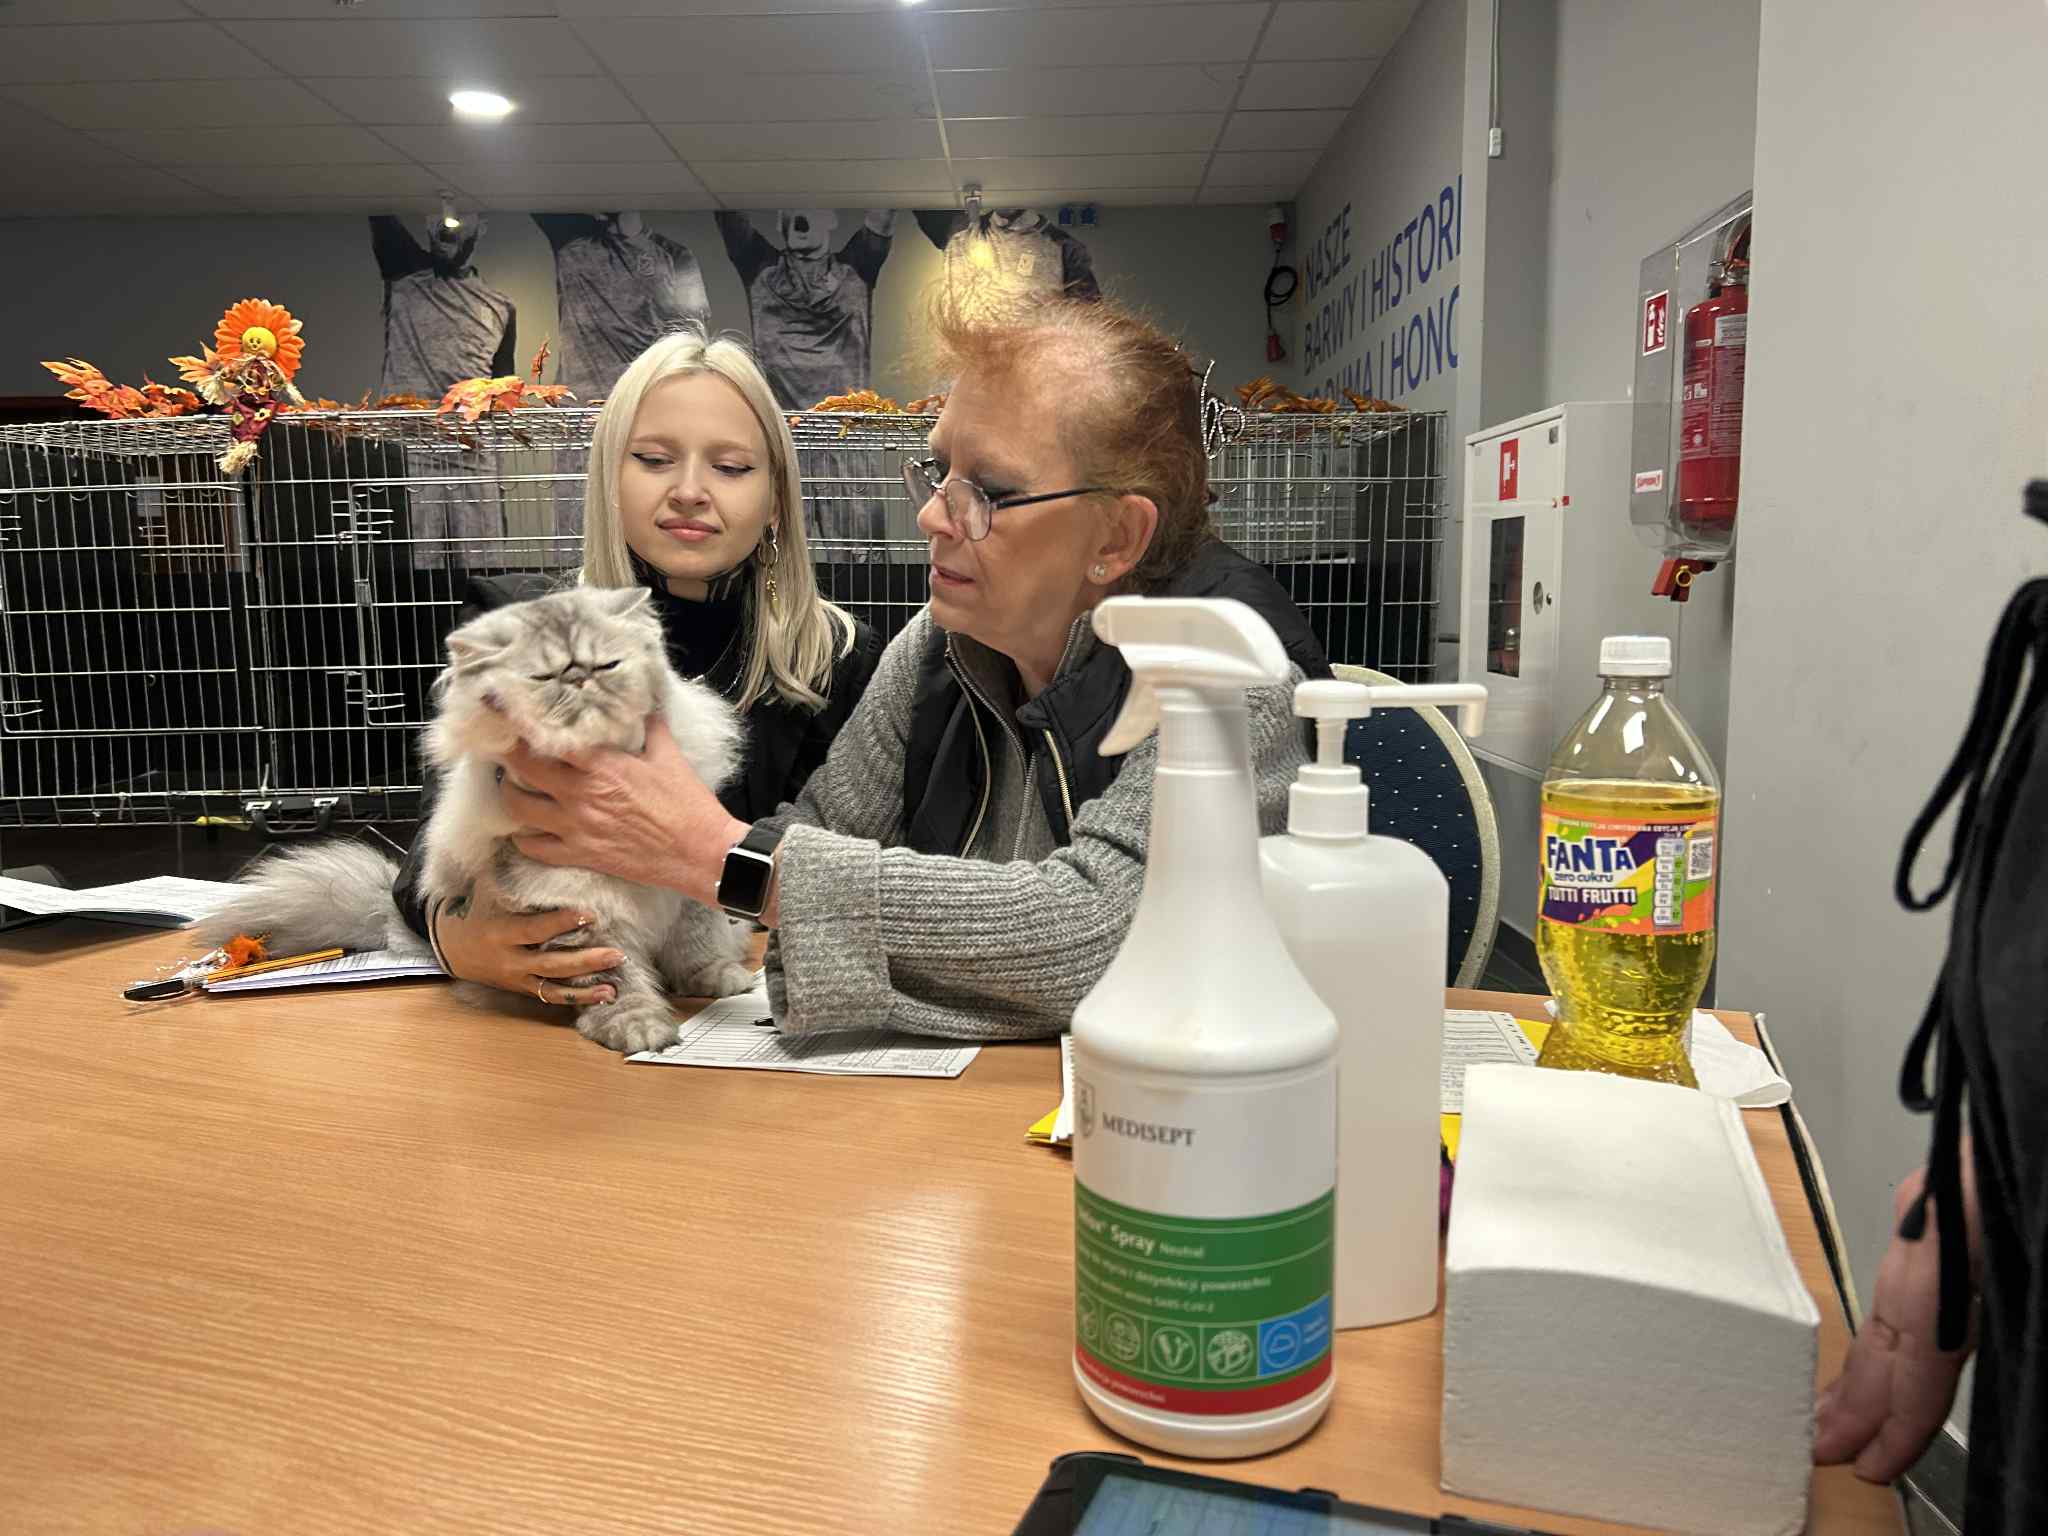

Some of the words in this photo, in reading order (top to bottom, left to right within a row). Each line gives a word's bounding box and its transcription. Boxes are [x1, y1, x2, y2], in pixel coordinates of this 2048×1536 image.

[1304, 202, 1351, 303] NASZE
[1304, 276, 1358, 376] BARWY
[1546, 835, 1636, 873] FANTA
[1554, 873, 1575, 882] zero
[1577, 871, 1614, 882] cukru
[1548, 886, 1578, 903] TUTTI
[1582, 888, 1637, 904] FRUTTI
[1102, 1112, 1197, 1147] MEDISEPT
[1111, 1223, 1155, 1257] Spray
